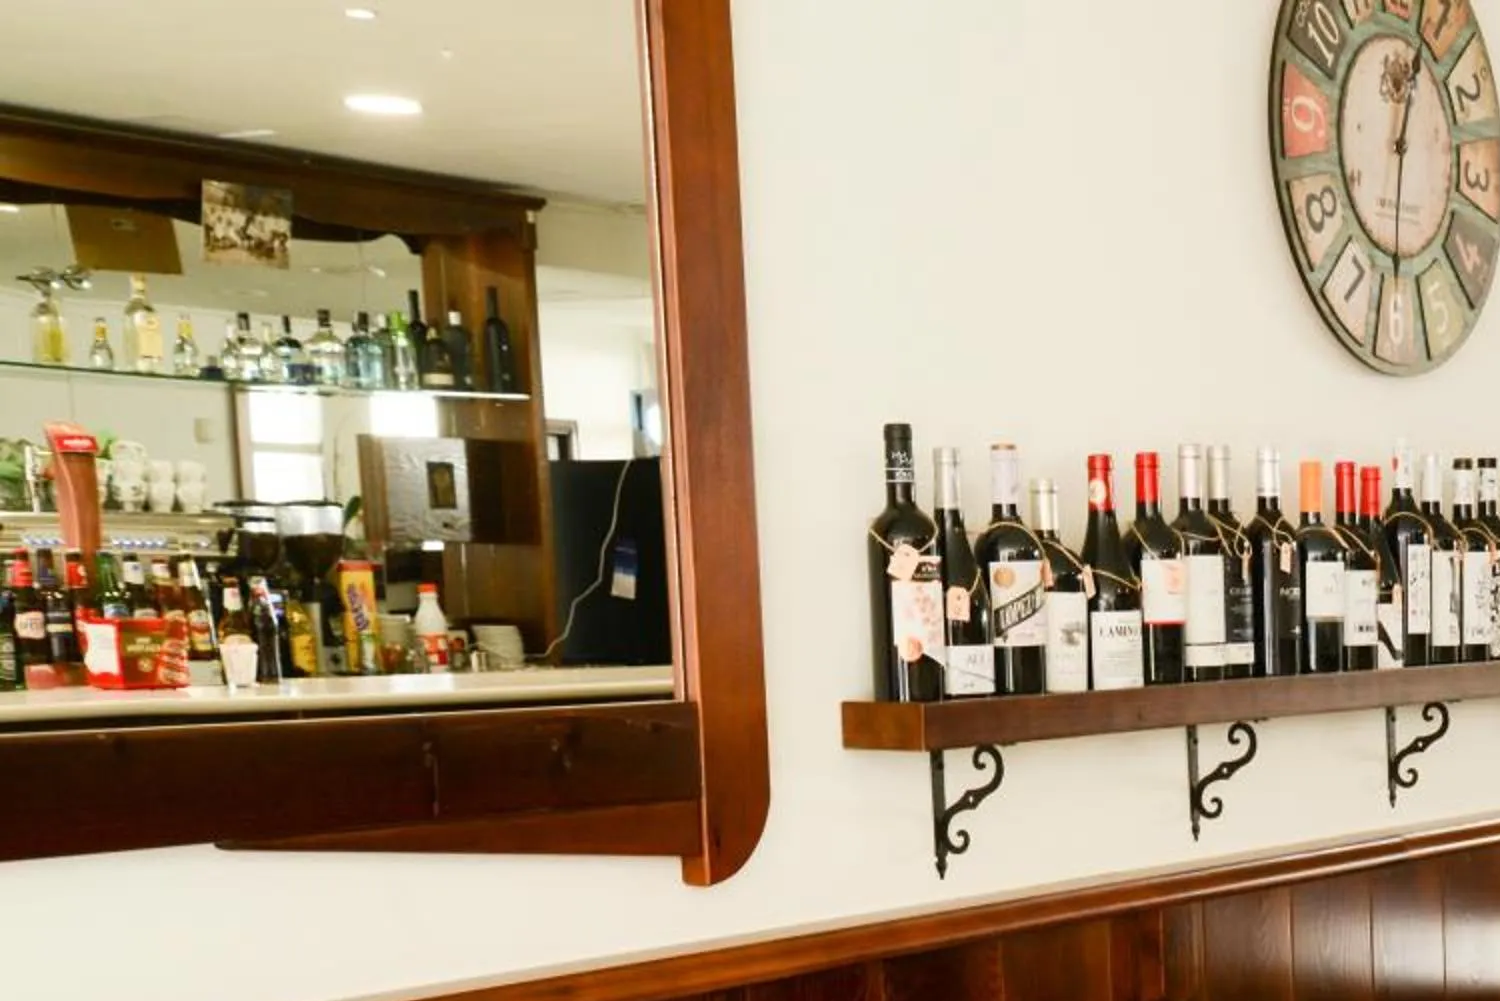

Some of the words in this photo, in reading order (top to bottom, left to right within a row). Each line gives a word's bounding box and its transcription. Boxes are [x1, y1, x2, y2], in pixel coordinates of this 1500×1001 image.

[1308, 2, 1339, 68] 10
[1455, 72, 1480, 112] 2
[1291, 95, 1325, 138] 9
[1464, 160, 1489, 192] 3
[1305, 185, 1337, 233] 8
[1455, 233, 1482, 275] 4
[1344, 255, 1366, 302] 7
[1388, 291, 1404, 345] 6
[1427, 281, 1449, 334] 5
